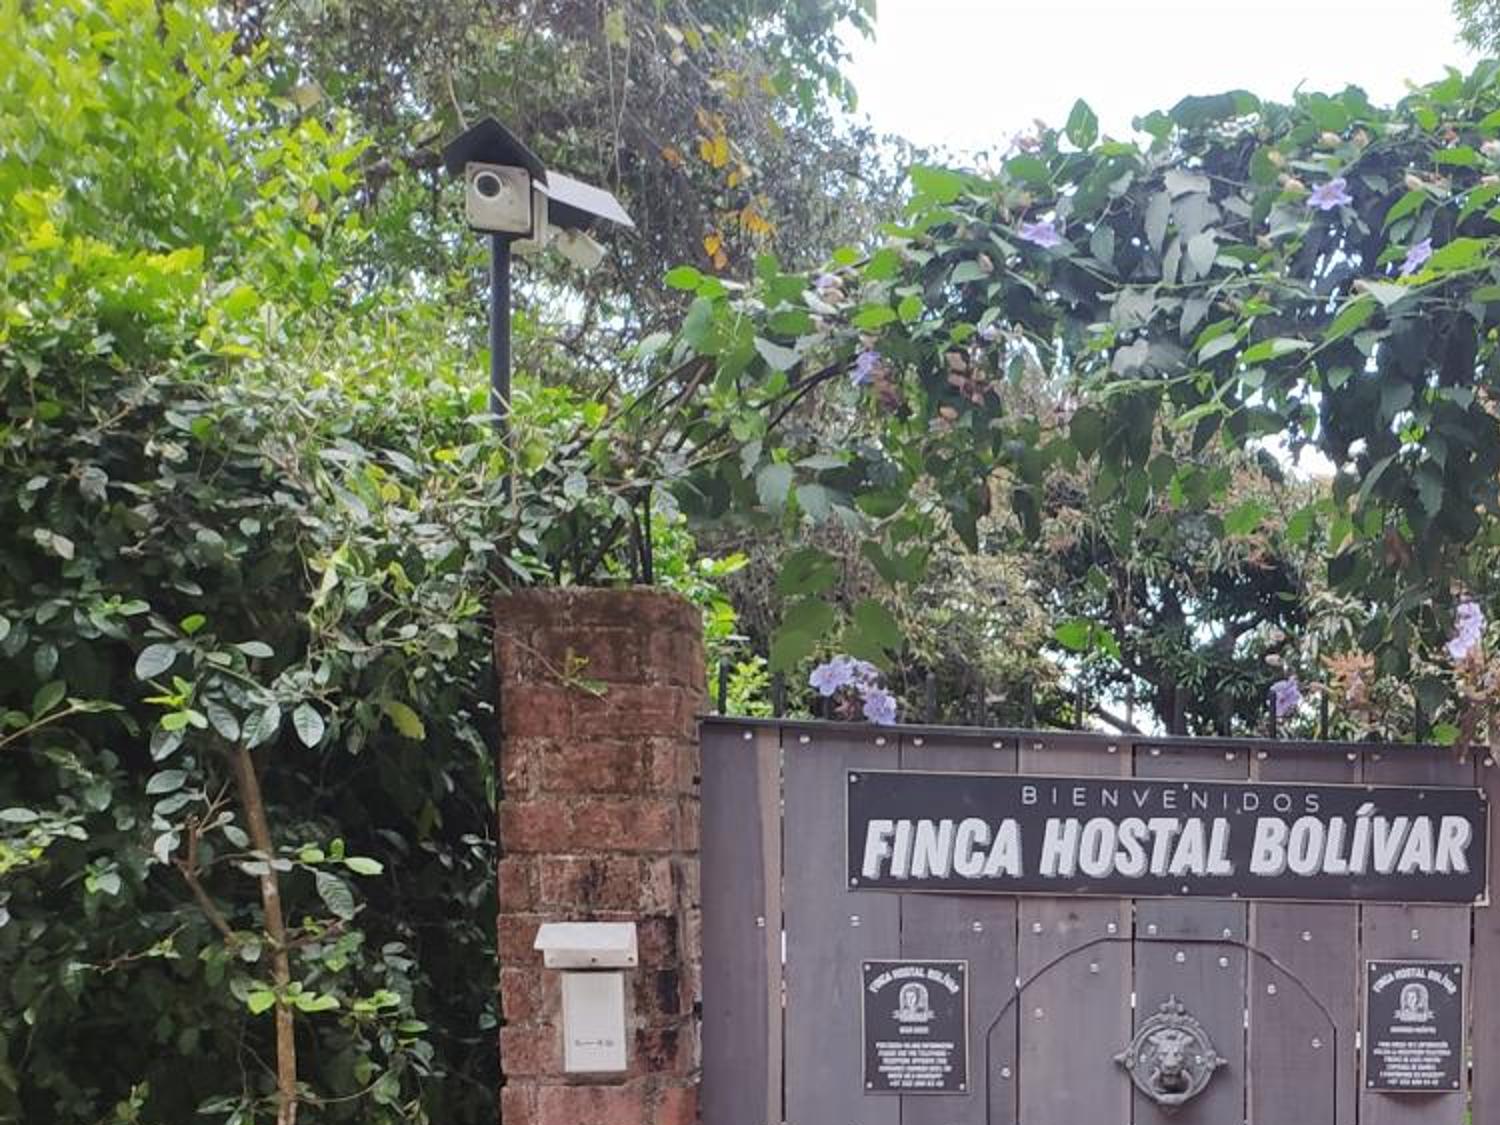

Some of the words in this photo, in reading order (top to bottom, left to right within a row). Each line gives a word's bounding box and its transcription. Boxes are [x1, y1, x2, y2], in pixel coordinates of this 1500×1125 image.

[1021, 785, 1319, 813] BIENVENIDOS
[862, 817, 1023, 878] FINCA
[1039, 816, 1236, 877] HOSTAL
[1249, 802, 1472, 876] BOLÍVAR
